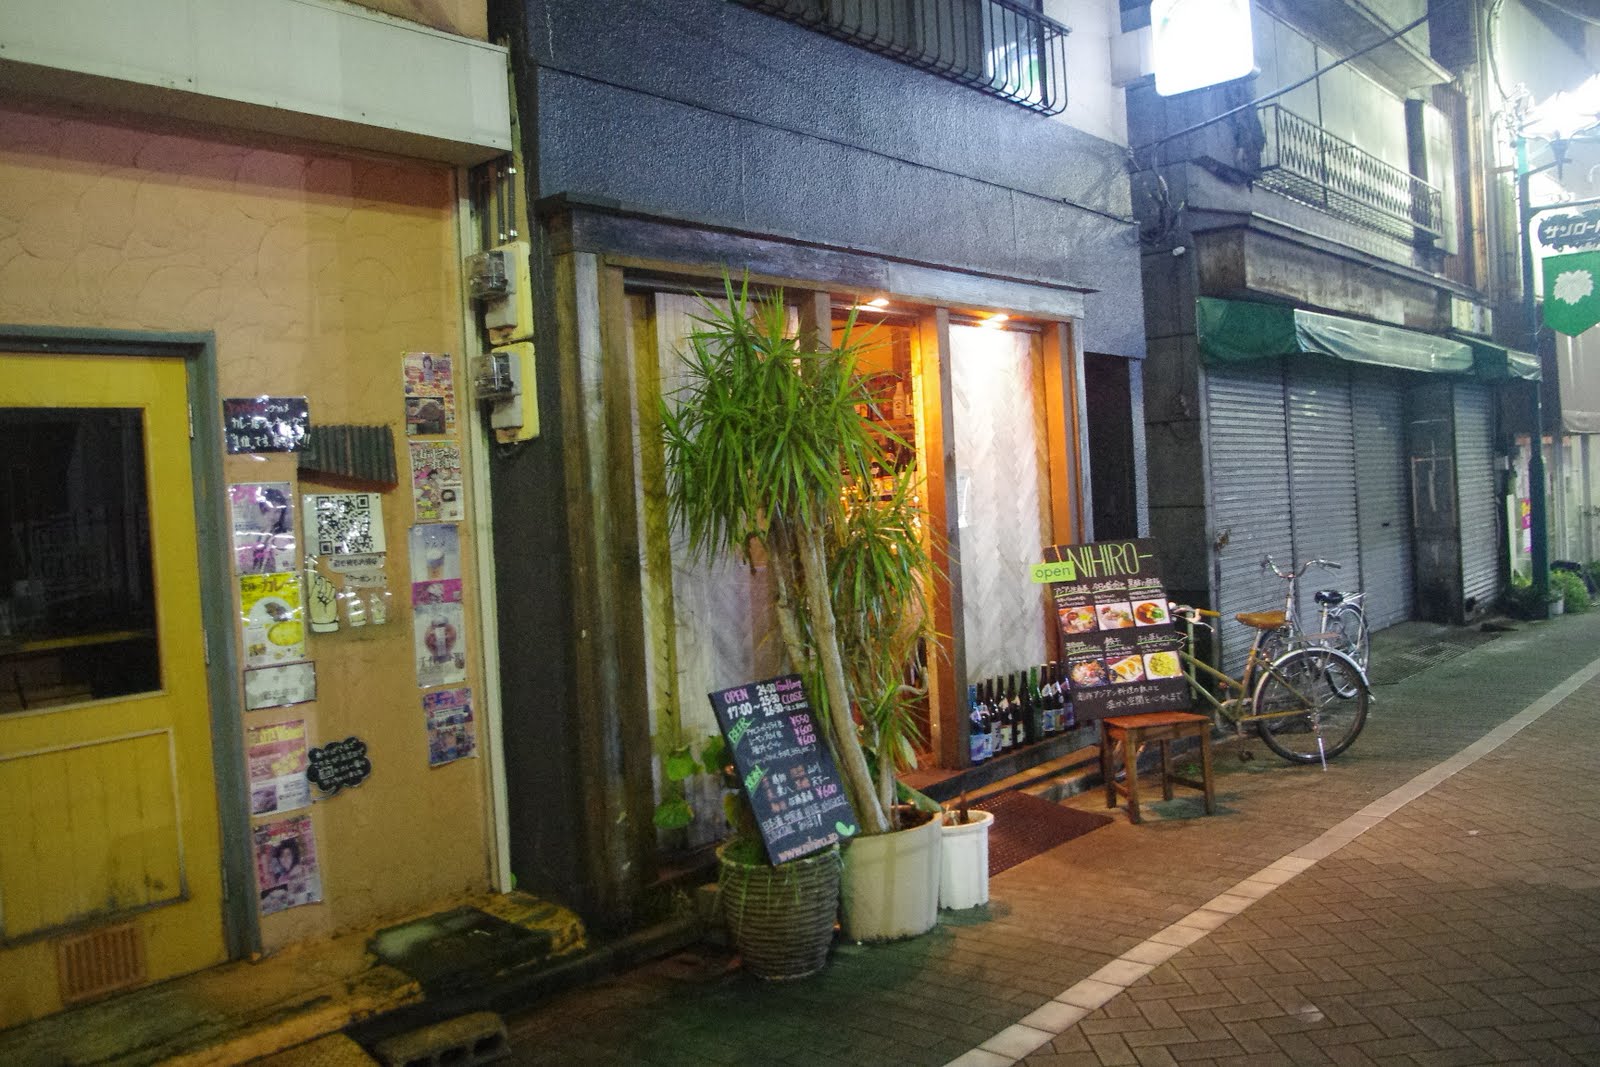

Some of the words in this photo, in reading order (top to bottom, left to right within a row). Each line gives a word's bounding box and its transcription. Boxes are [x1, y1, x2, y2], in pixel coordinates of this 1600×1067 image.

[1035, 567, 1072, 580] open
[724, 688, 749, 704] OPEN
[781, 691, 806, 705] CLOSE
[728, 717, 750, 744] BEER
